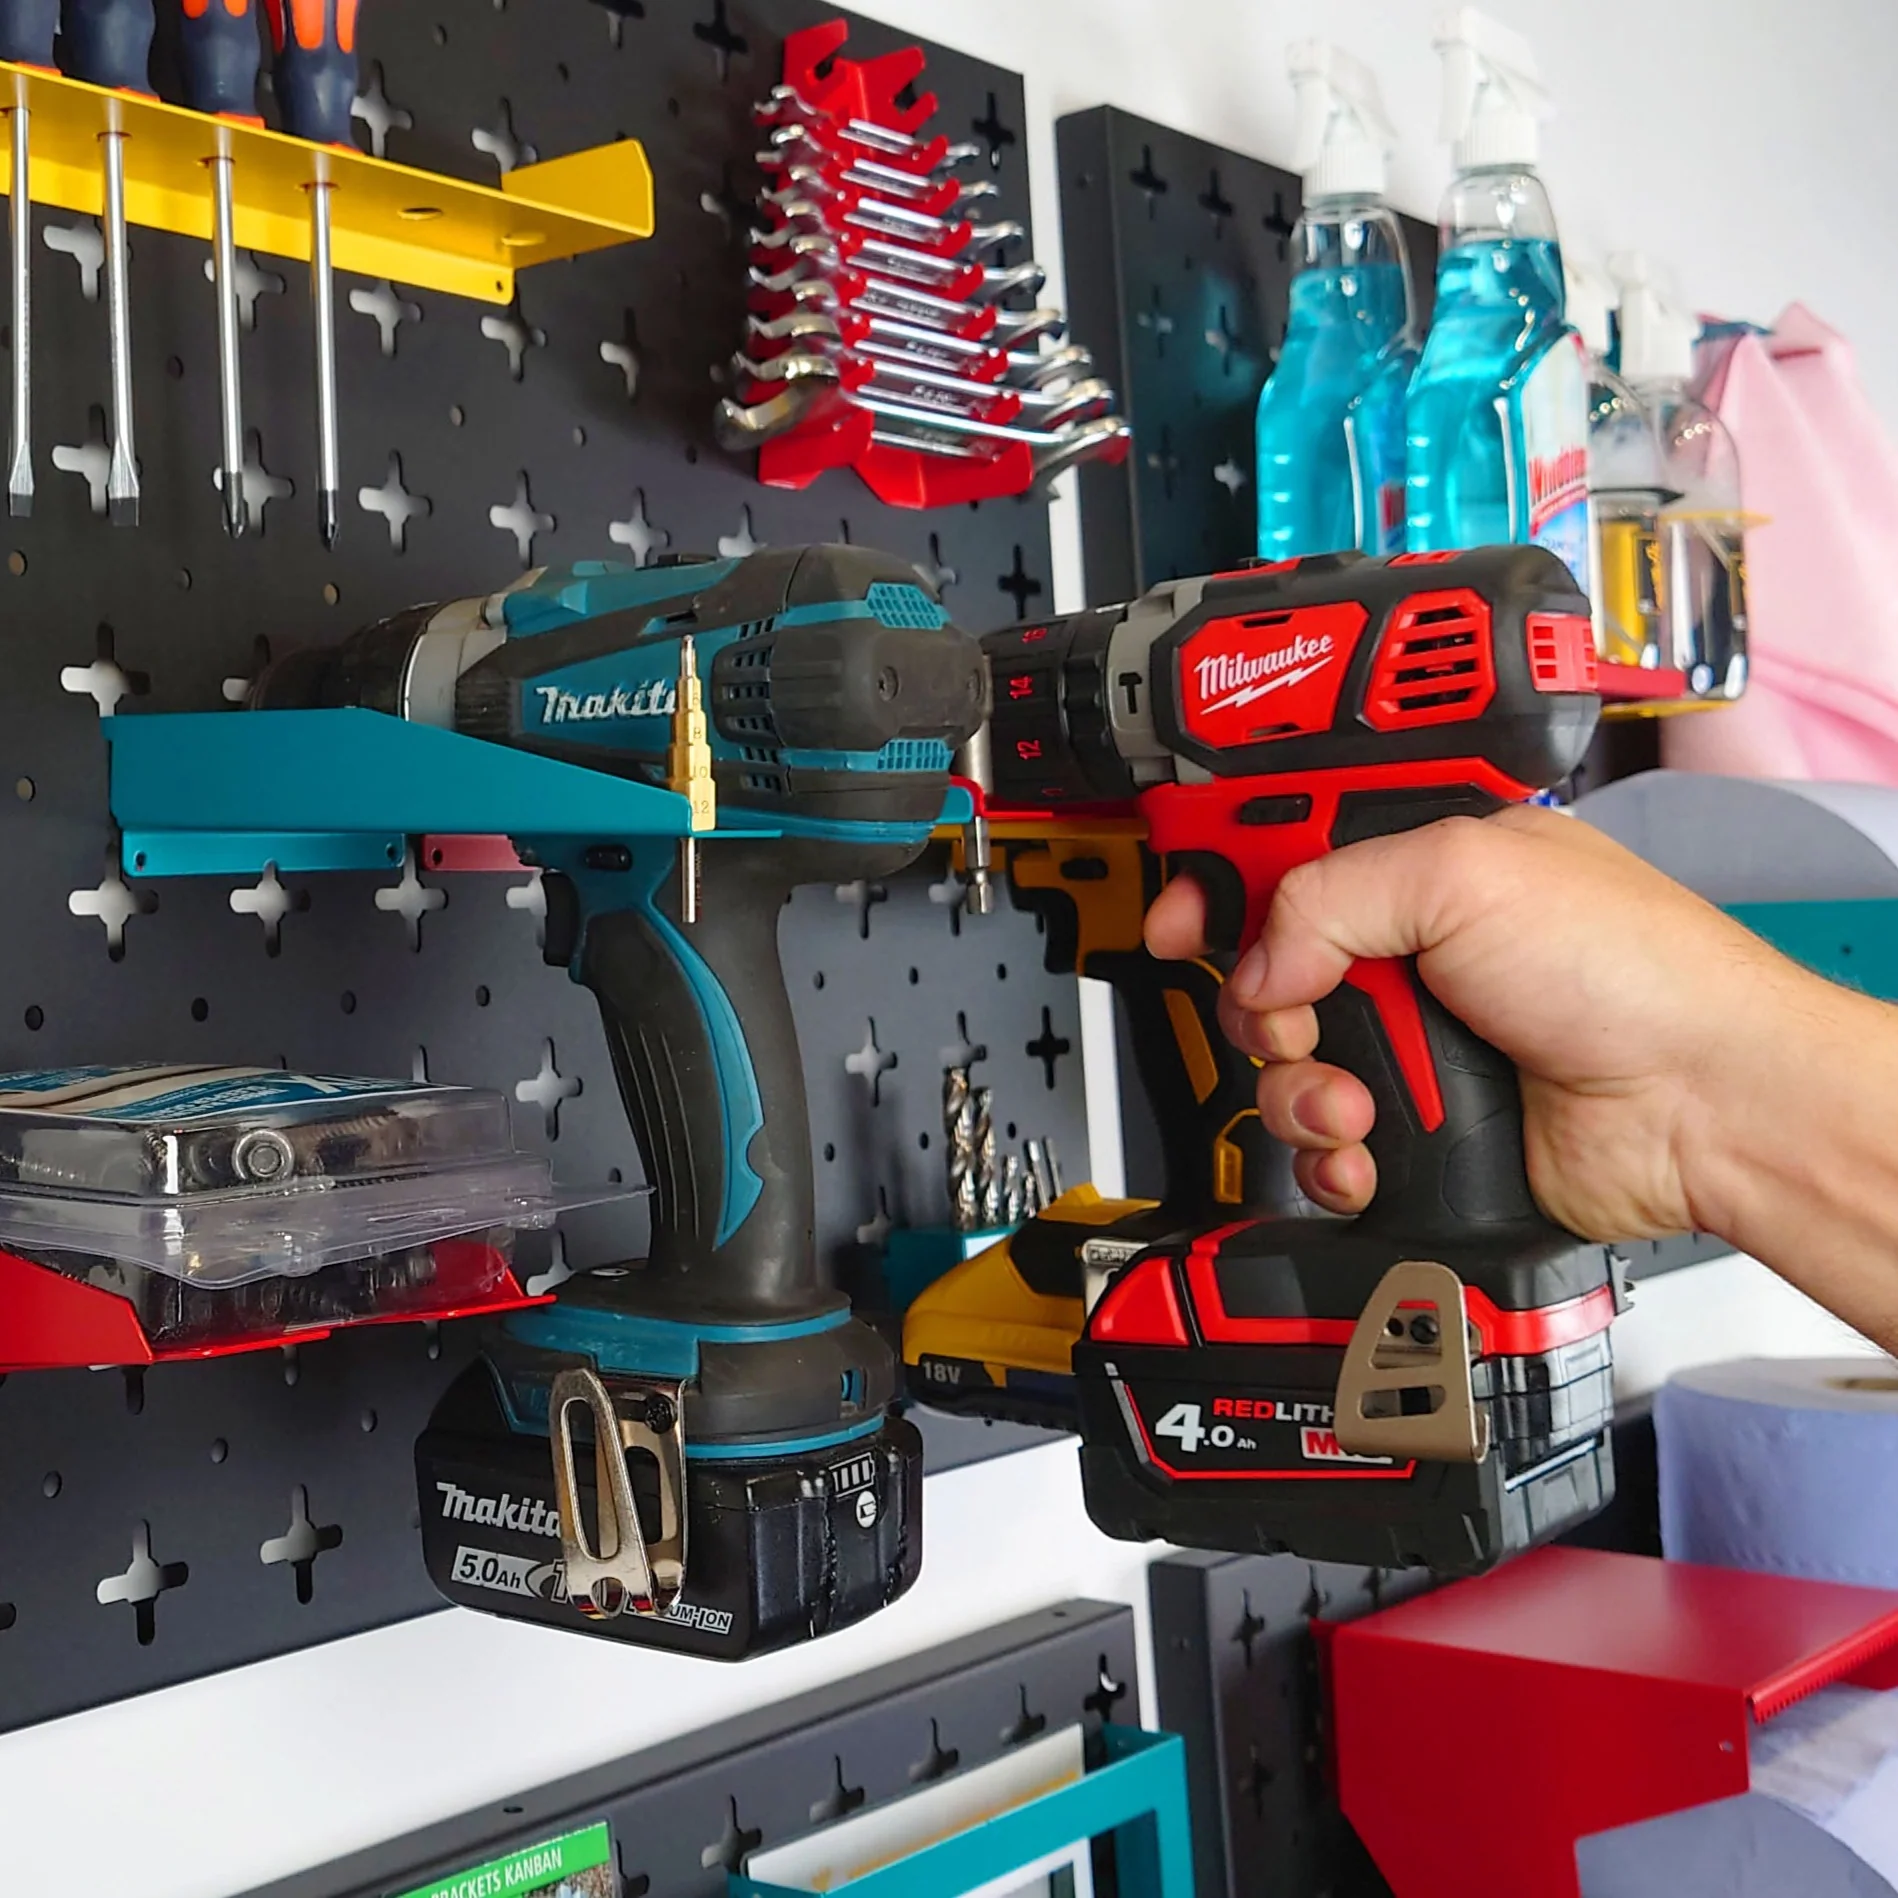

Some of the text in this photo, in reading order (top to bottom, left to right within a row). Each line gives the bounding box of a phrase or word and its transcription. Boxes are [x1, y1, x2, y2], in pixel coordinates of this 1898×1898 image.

[1194, 634, 1334, 700] Milwaukee
[1009, 675, 1033, 700] 14
[693, 727, 702, 739] 8
[1016, 740, 1042, 760] 12
[692, 766, 708, 778] 10
[692, 801, 709, 814] 12
[922, 1361, 961, 1385] 18V
[1213, 1398, 1335, 1423] REDLITH
[459, 1554, 521, 1589] 5.0Ah
[624, 1601, 730, 1628] LUM-ION
[431, 1846, 562, 1898] ACKETS KANBAN
